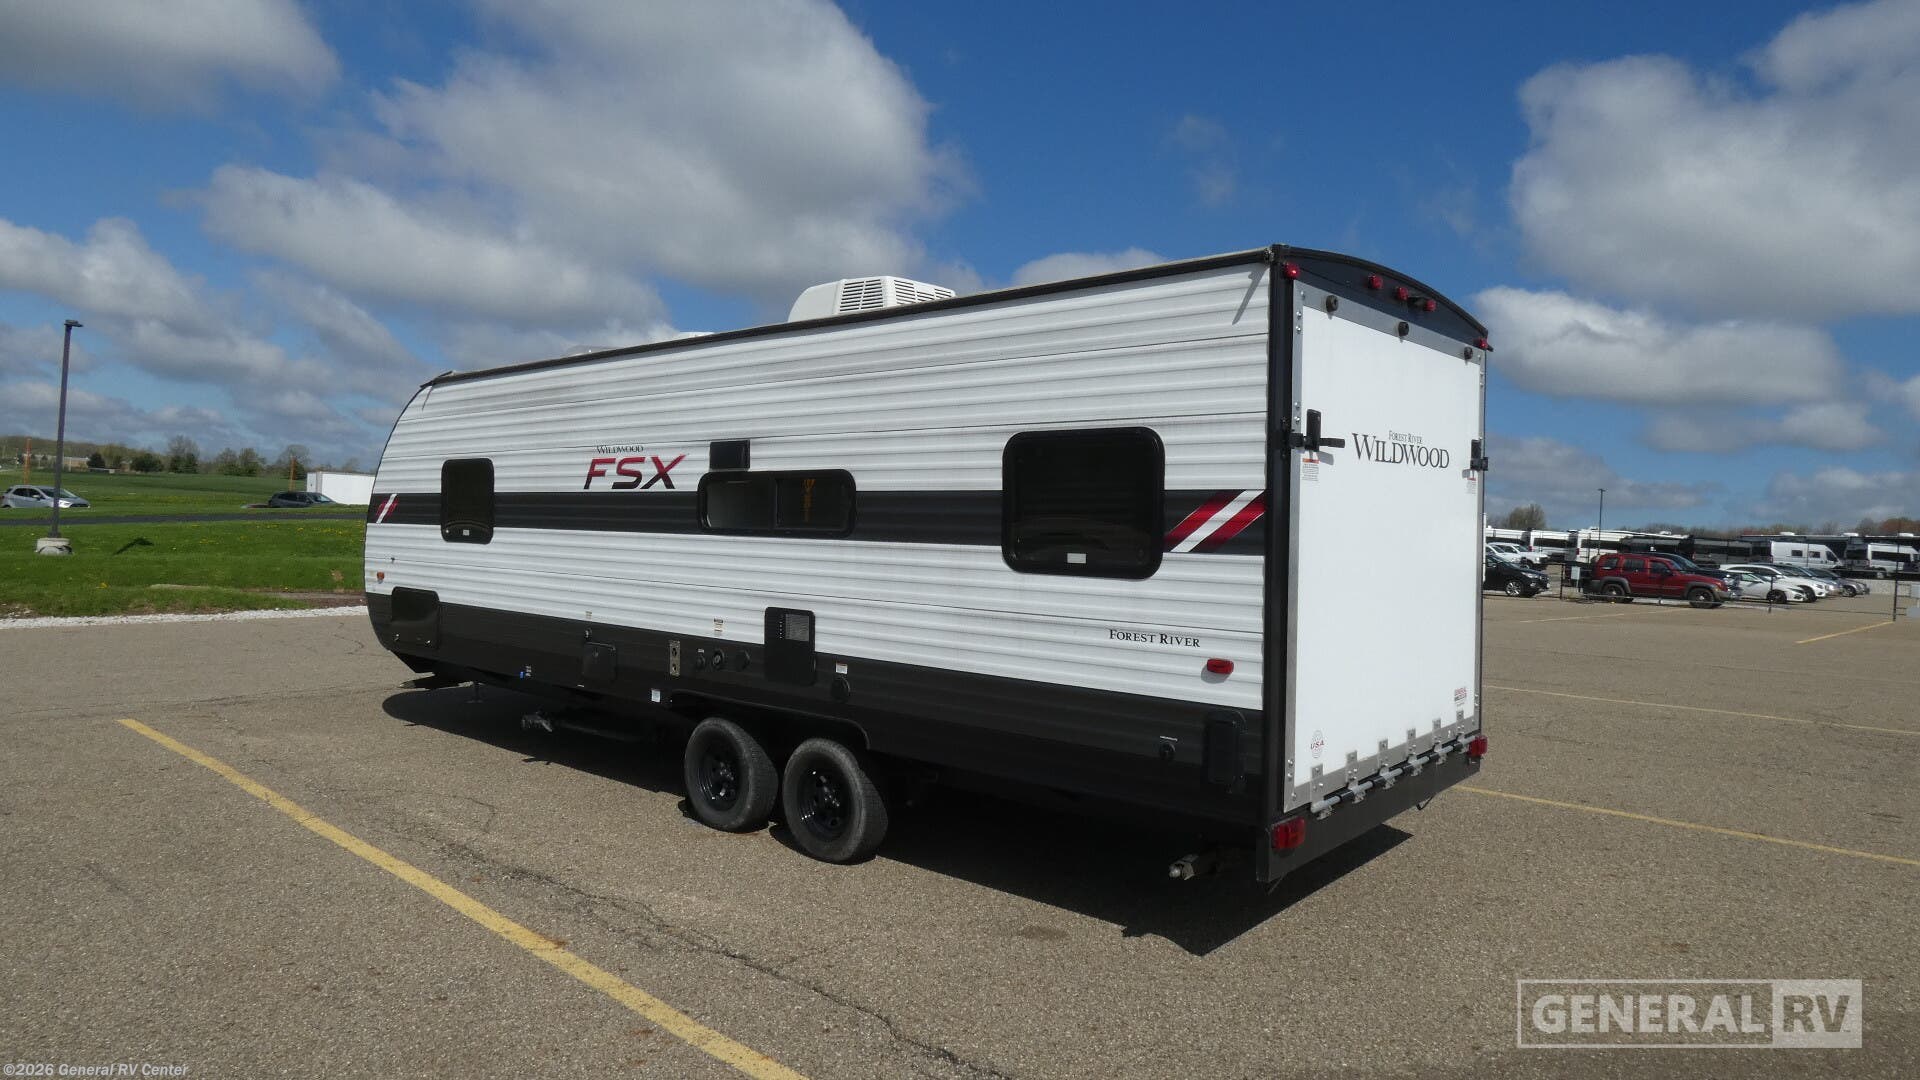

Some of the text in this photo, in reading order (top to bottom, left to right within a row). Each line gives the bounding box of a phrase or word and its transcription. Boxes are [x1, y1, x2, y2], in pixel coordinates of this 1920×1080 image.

[596, 445, 644, 454] WILDWOOD
[1352, 433, 1450, 469] WILDWOOD
[583, 454, 687, 490] FSX
[1109, 629, 1200, 648] FOREST RIVER
